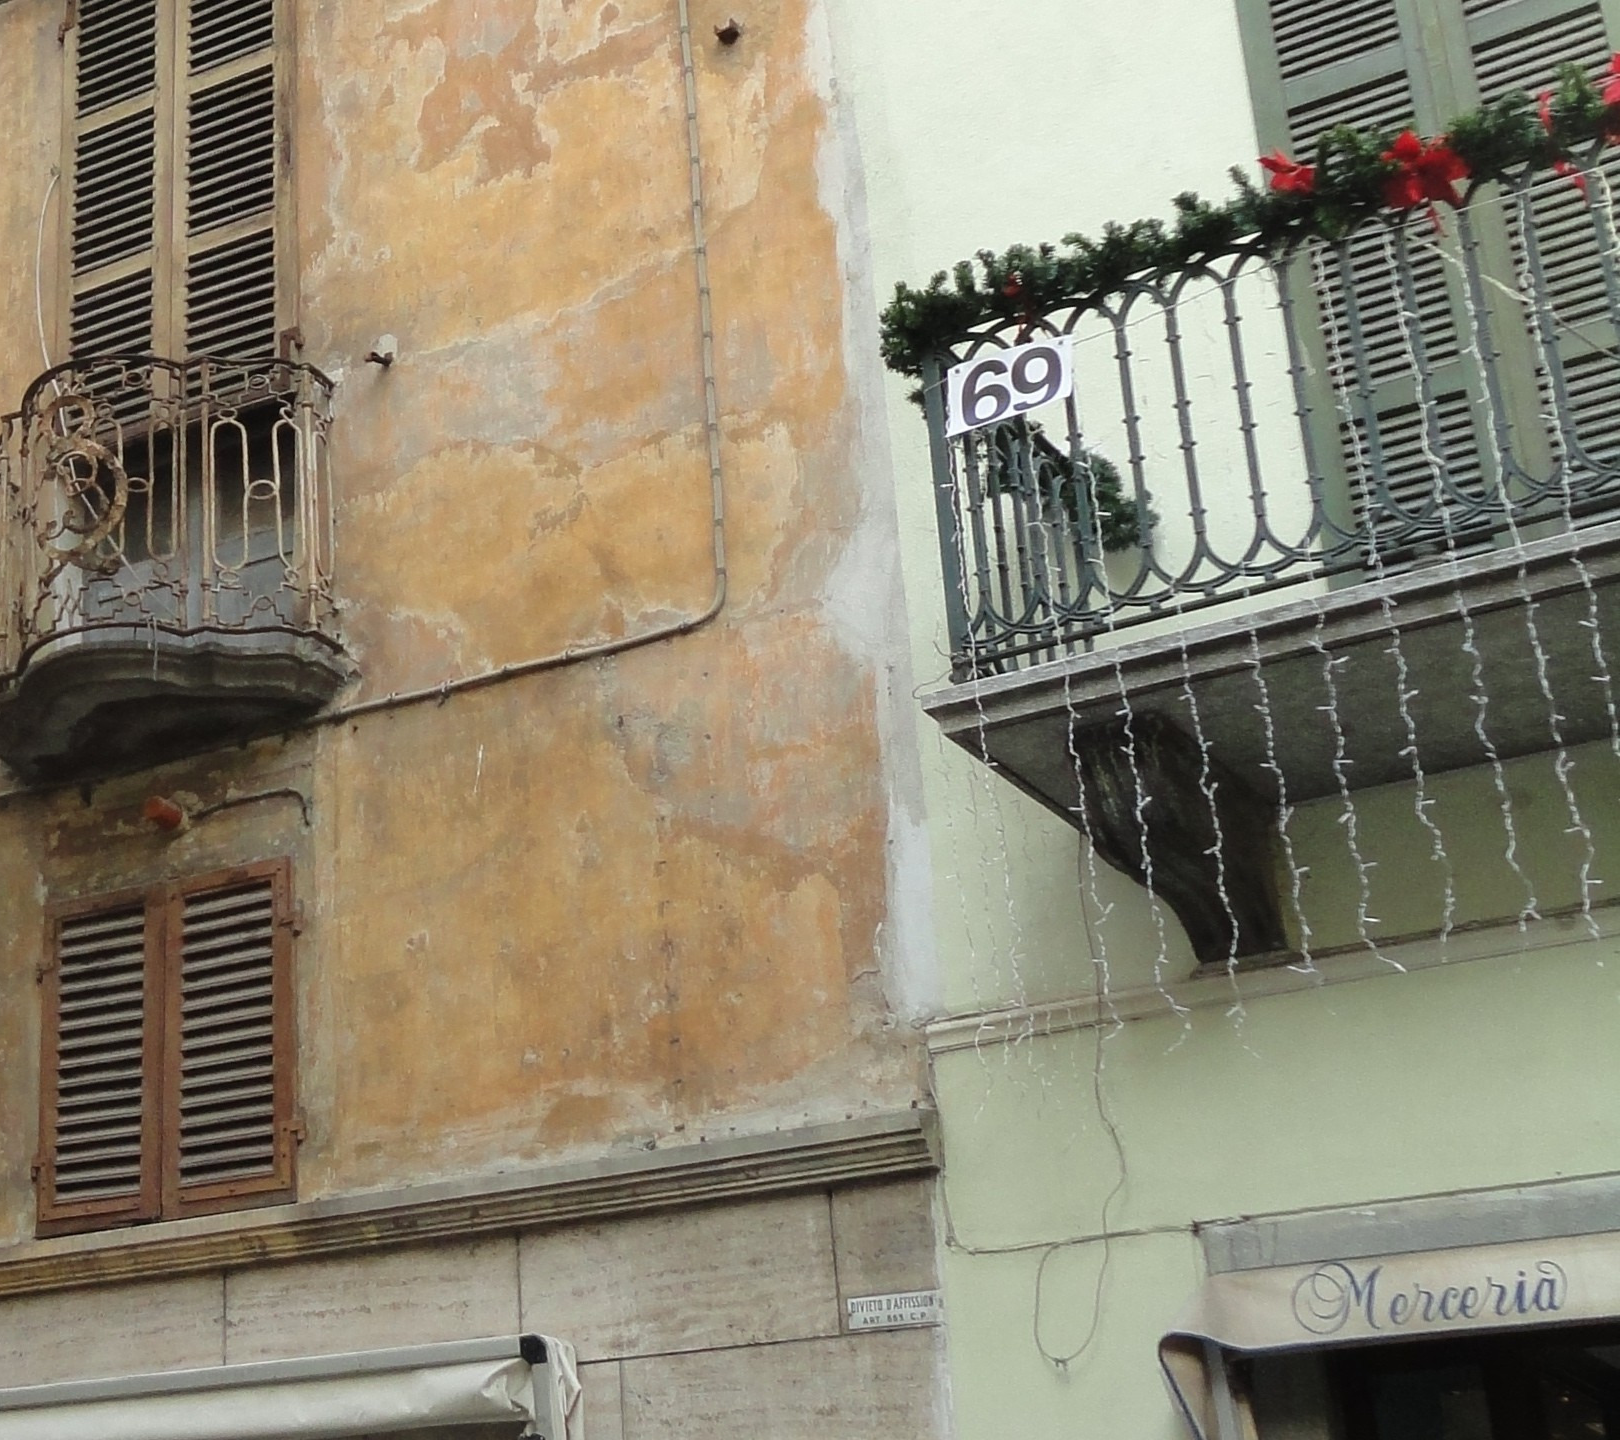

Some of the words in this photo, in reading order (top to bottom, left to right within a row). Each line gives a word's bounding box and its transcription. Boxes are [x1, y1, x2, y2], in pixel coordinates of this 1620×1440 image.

[961, 346, 1063, 427] 69
[850, 1299, 883, 1314] DIVIETO
[886, 1295, 937, 1311] D'AFFISSION
[1291, 1260, 1569, 1335] Merceria
